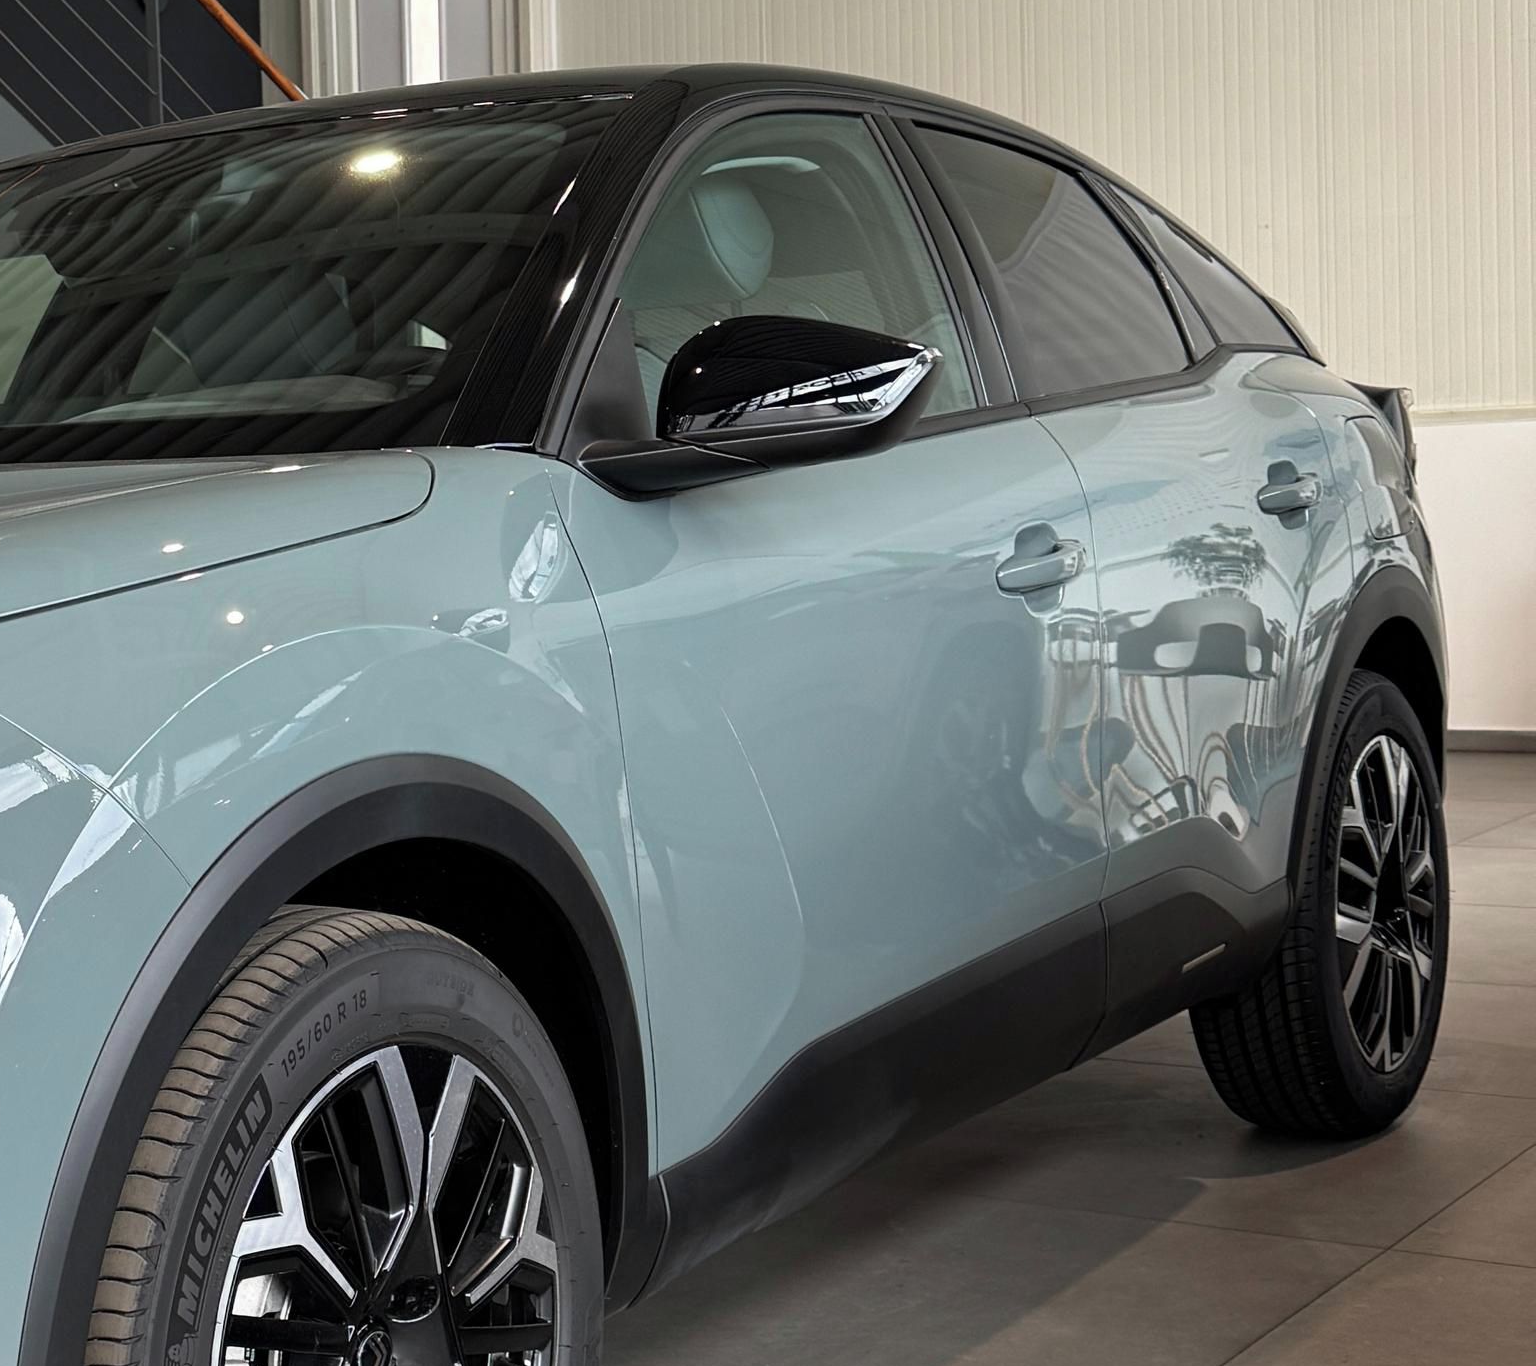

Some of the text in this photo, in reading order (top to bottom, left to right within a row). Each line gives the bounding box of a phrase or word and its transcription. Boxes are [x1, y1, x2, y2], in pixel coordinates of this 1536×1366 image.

[280, 1013, 332, 1077] 195/60
[337, 1002, 349, 1022] R
[352, 988, 369, 1012] 18
[177, 1088, 268, 1329] MICHELIN
